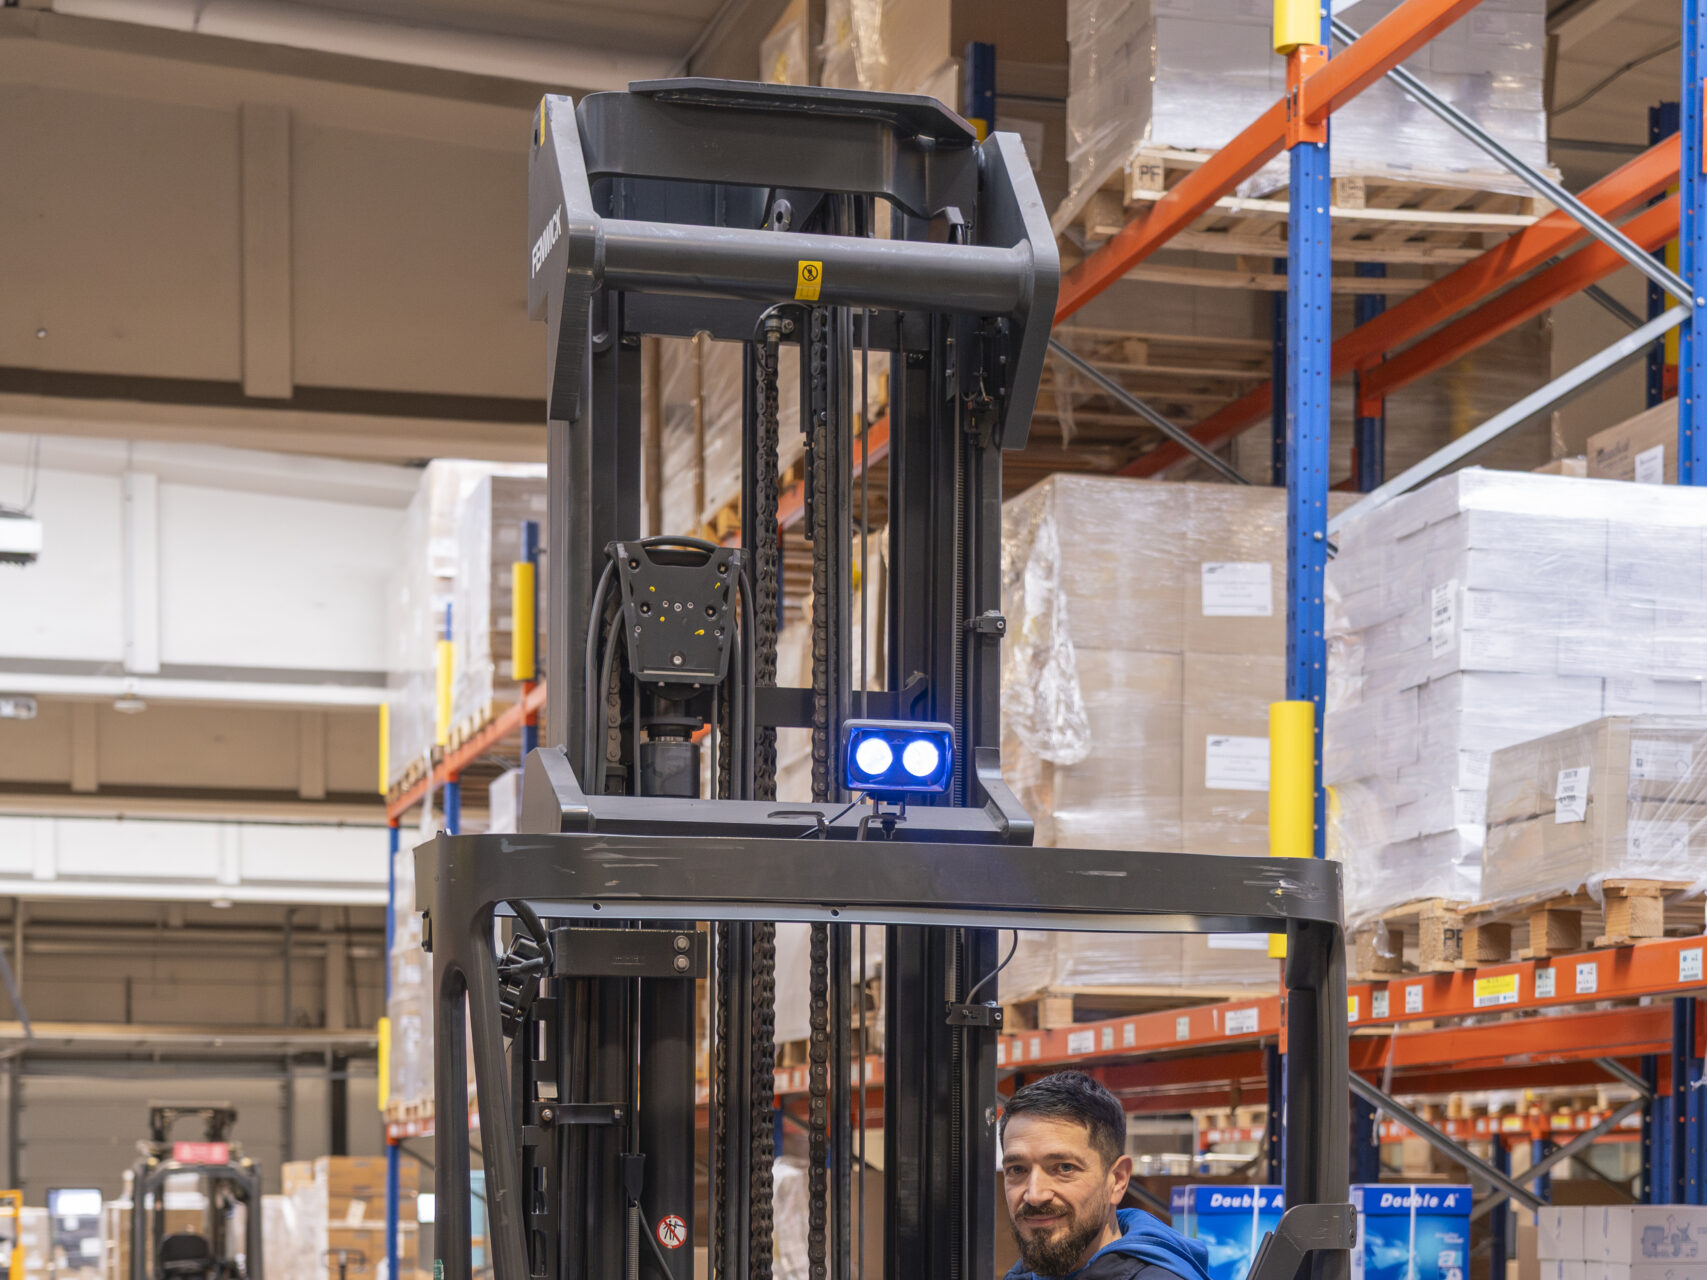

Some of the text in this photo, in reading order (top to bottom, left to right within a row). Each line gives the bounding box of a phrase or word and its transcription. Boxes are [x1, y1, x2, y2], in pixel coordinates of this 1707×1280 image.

[1139, 165, 1161, 182] PF
[531, 203, 562, 279] FENWICK
[1271, 1193, 1284, 1208] A
[1380, 1193, 1456, 1208] Double A
